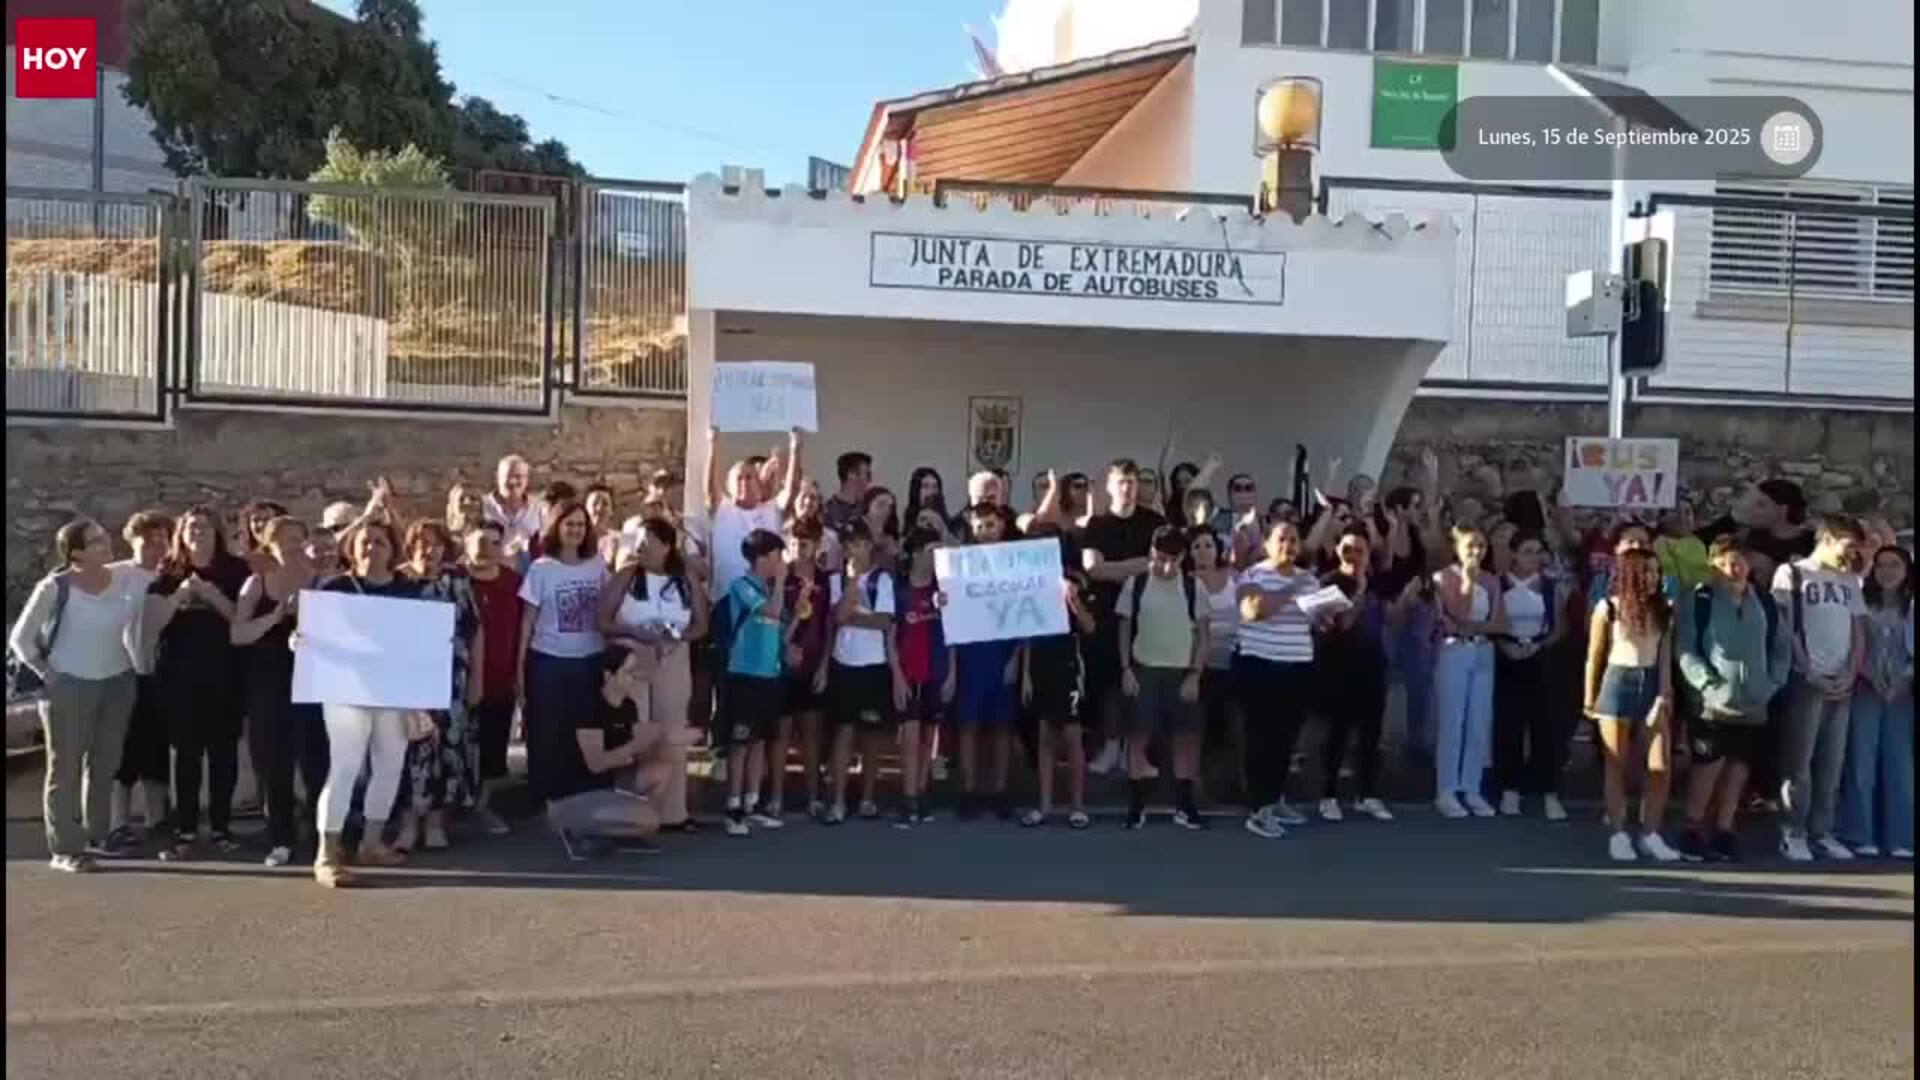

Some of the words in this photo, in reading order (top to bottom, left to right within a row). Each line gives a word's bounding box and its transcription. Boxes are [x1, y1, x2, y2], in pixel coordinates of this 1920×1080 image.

[911, 239, 990, 267] JUNTA
[1018, 244, 1044, 269] DE
[1070, 246, 1243, 280] EXTREMADURA
[938, 268, 1032, 289] PARADA
[1043, 273, 1073, 292] DE
[1083, 275, 1219, 299] AUTOBUSES
[1602, 471, 1663, 504] YA!
[986, 596, 1046, 630] YA
